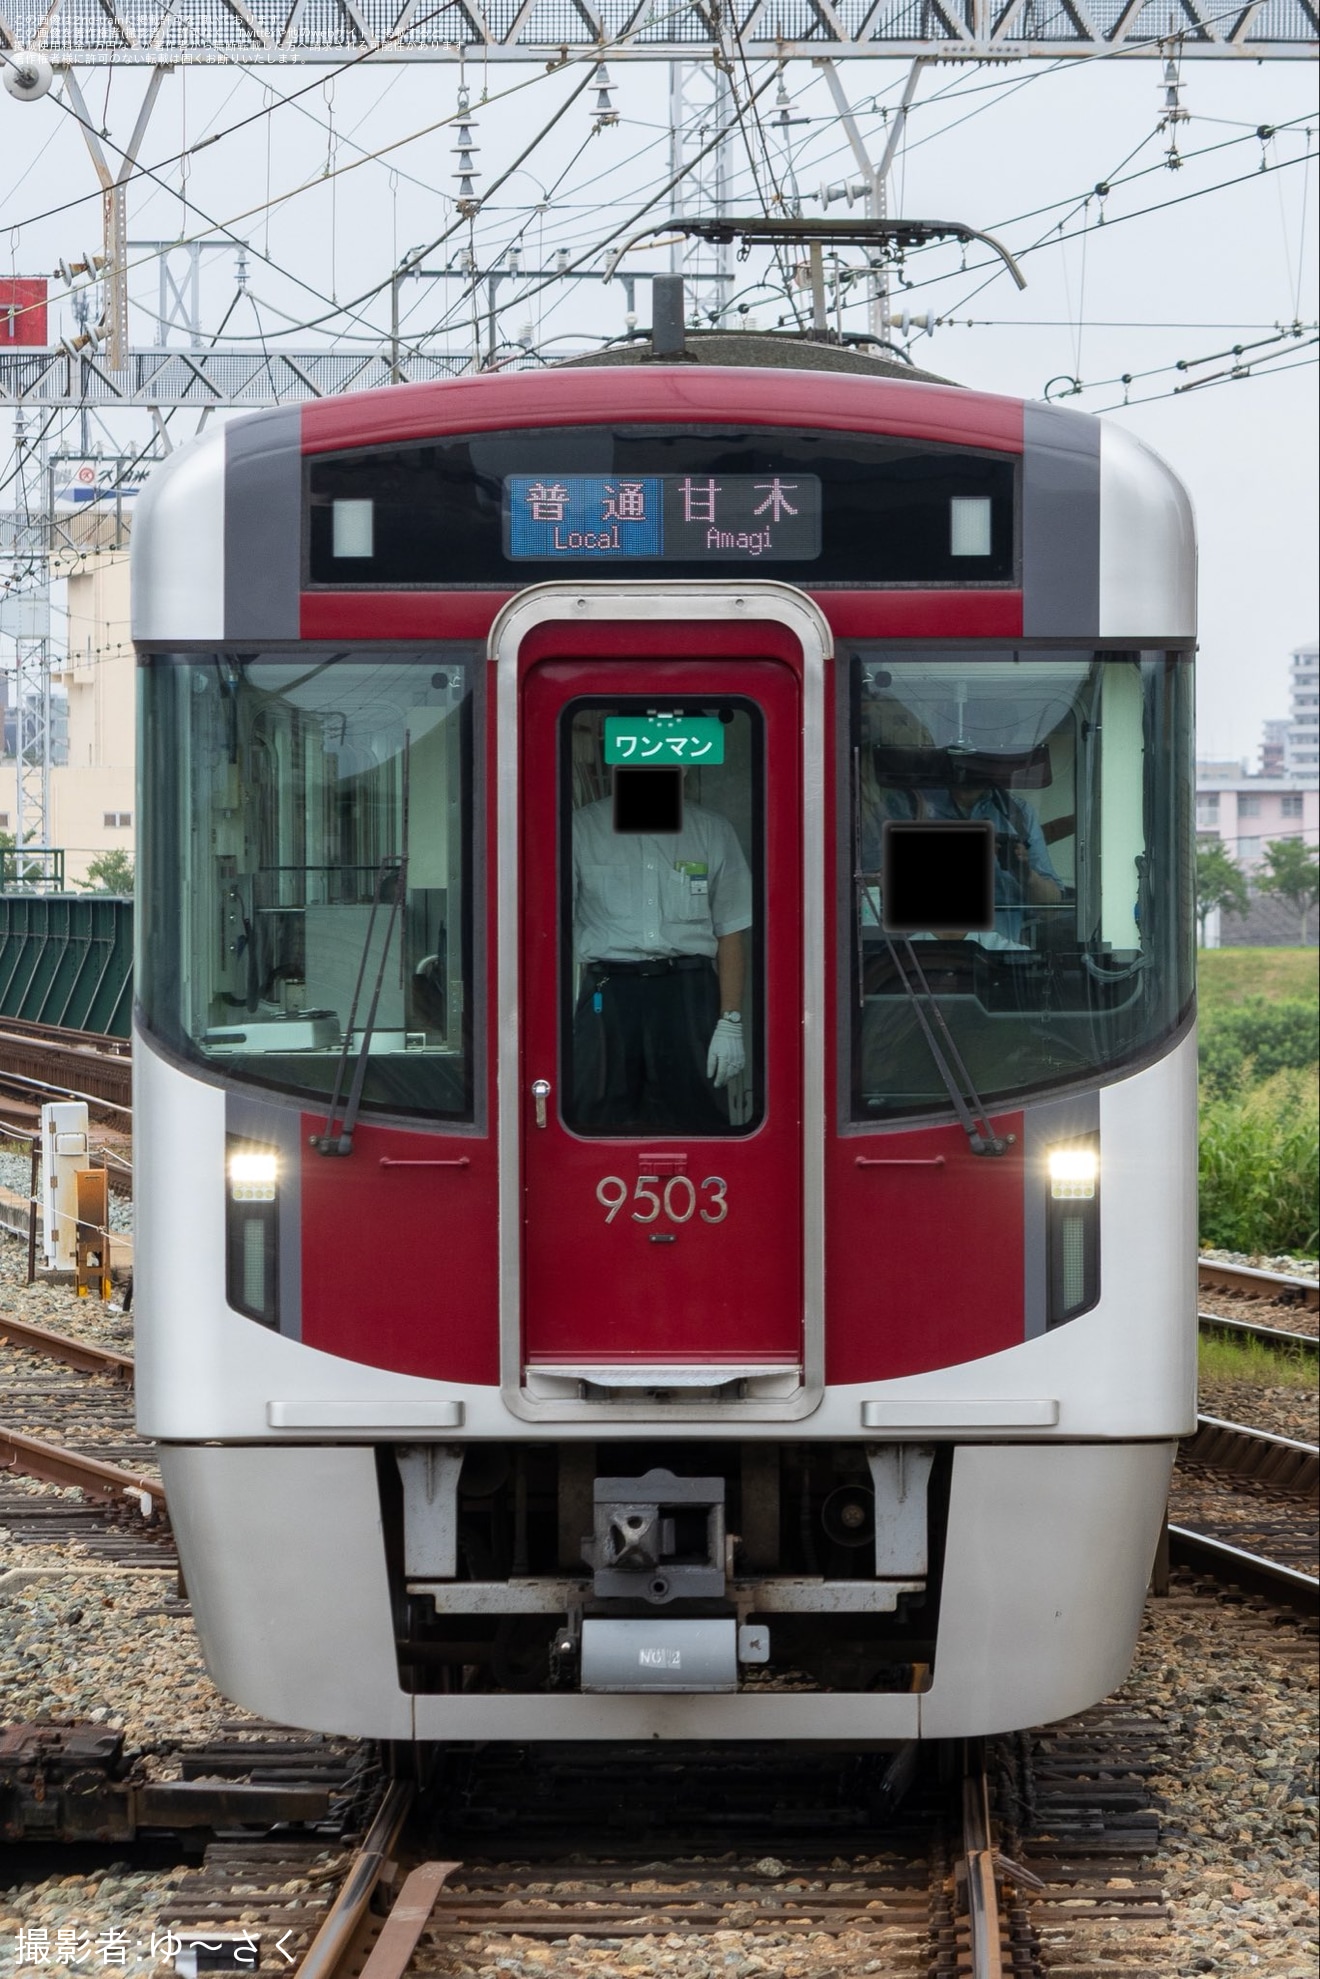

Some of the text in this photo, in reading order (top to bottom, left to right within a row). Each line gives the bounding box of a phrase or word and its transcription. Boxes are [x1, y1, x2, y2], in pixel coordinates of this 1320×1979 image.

[526, 482, 647, 522] 普通
[678, 478, 799, 522] 甘木
[553, 526, 621, 550] Local
[707, 526, 772, 556] Amagi
[615, 736, 713, 758] ワンマン
[596, 1175, 729, 1225] 9503
